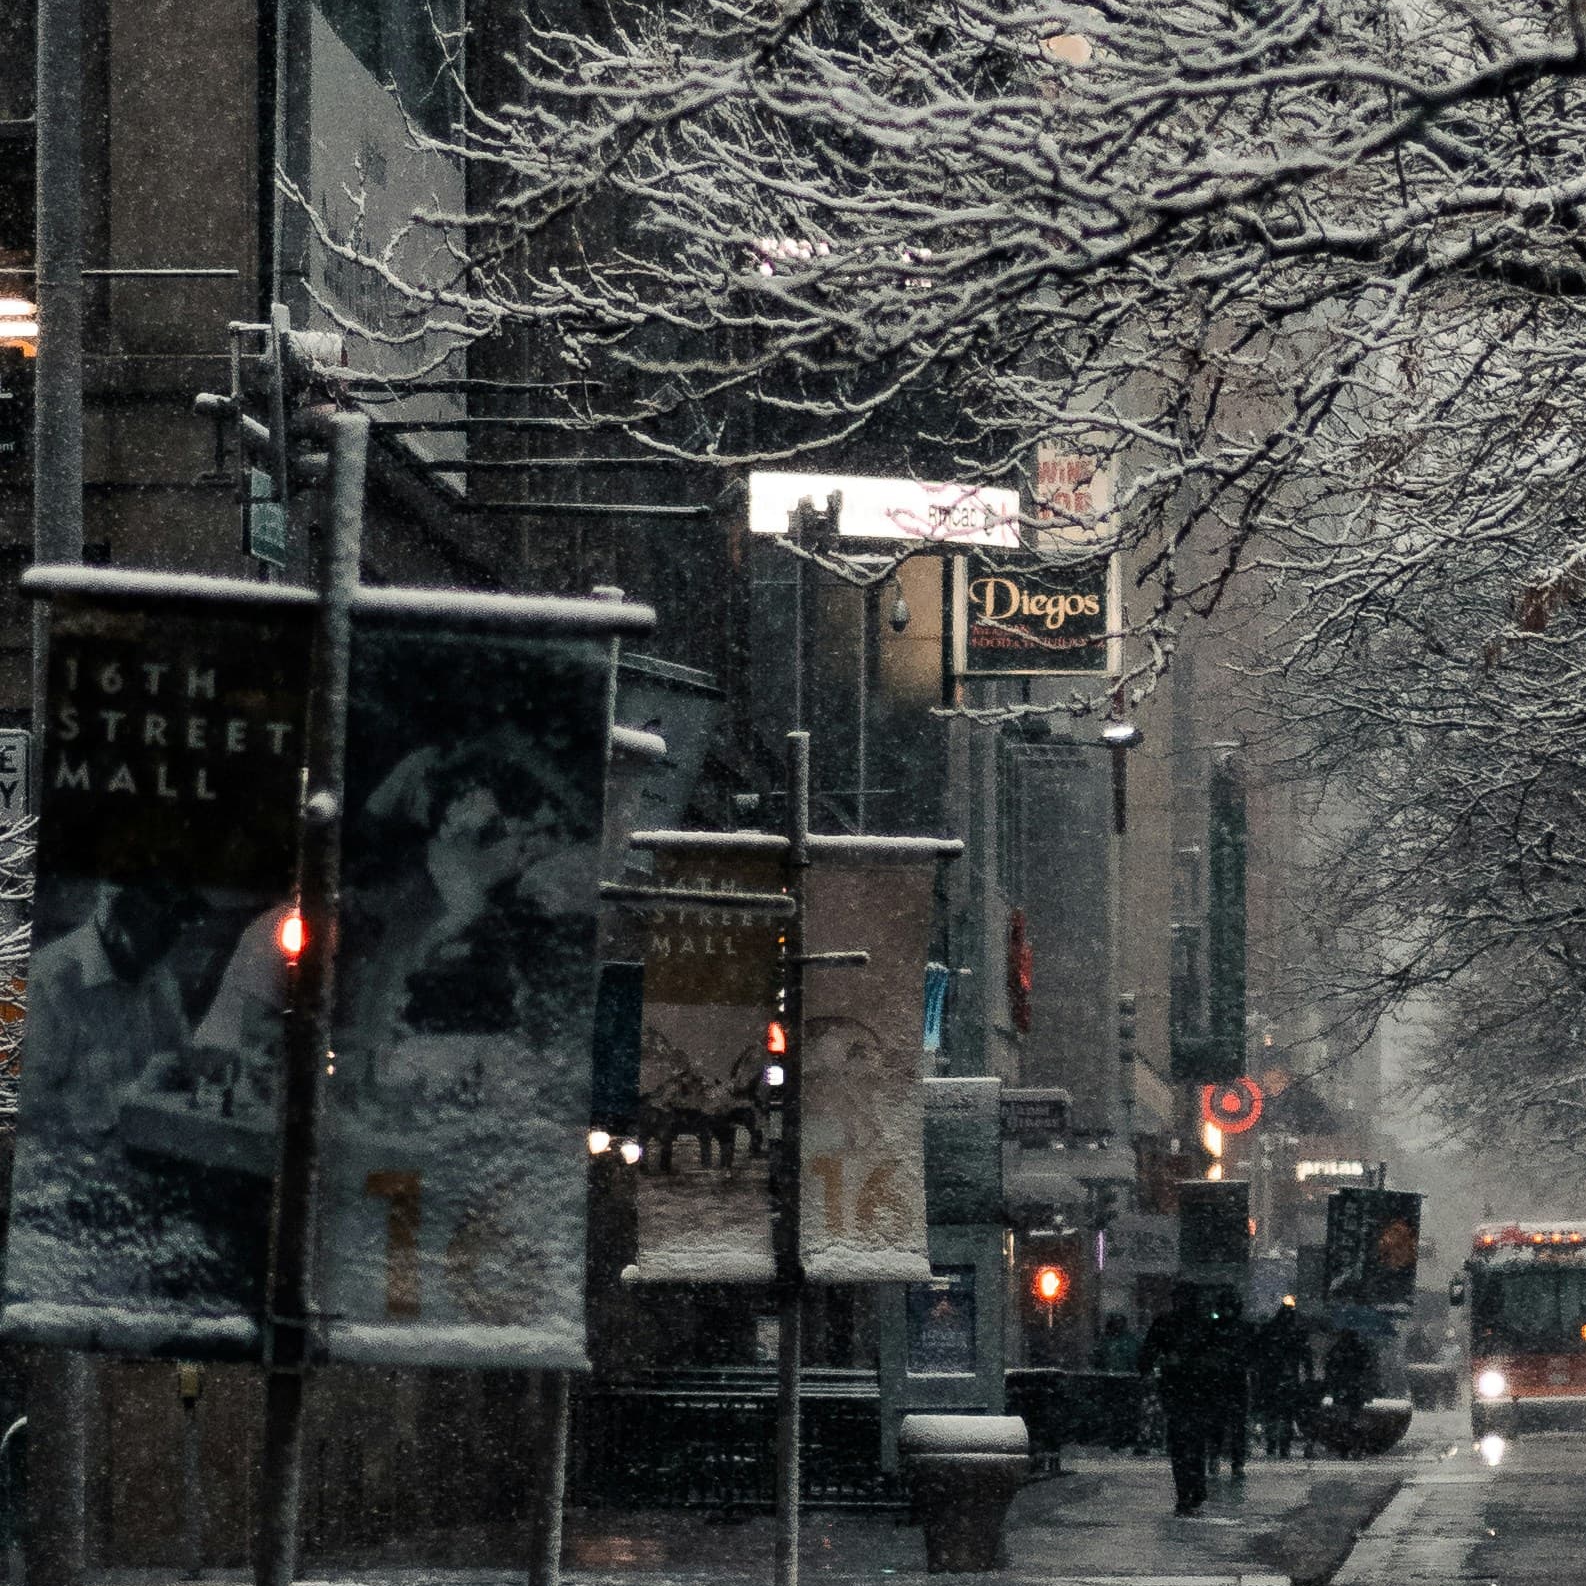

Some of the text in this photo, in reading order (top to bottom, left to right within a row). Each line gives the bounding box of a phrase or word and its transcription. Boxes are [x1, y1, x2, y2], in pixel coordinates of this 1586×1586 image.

[969, 577, 1101, 630] Diegos
[65, 657, 216, 699] 16TH
[58, 706, 292, 755] STREET
[54, 759, 217, 800] MALL
[651, 934, 737, 957] MALL
[810, 1155, 912, 1245] 16
